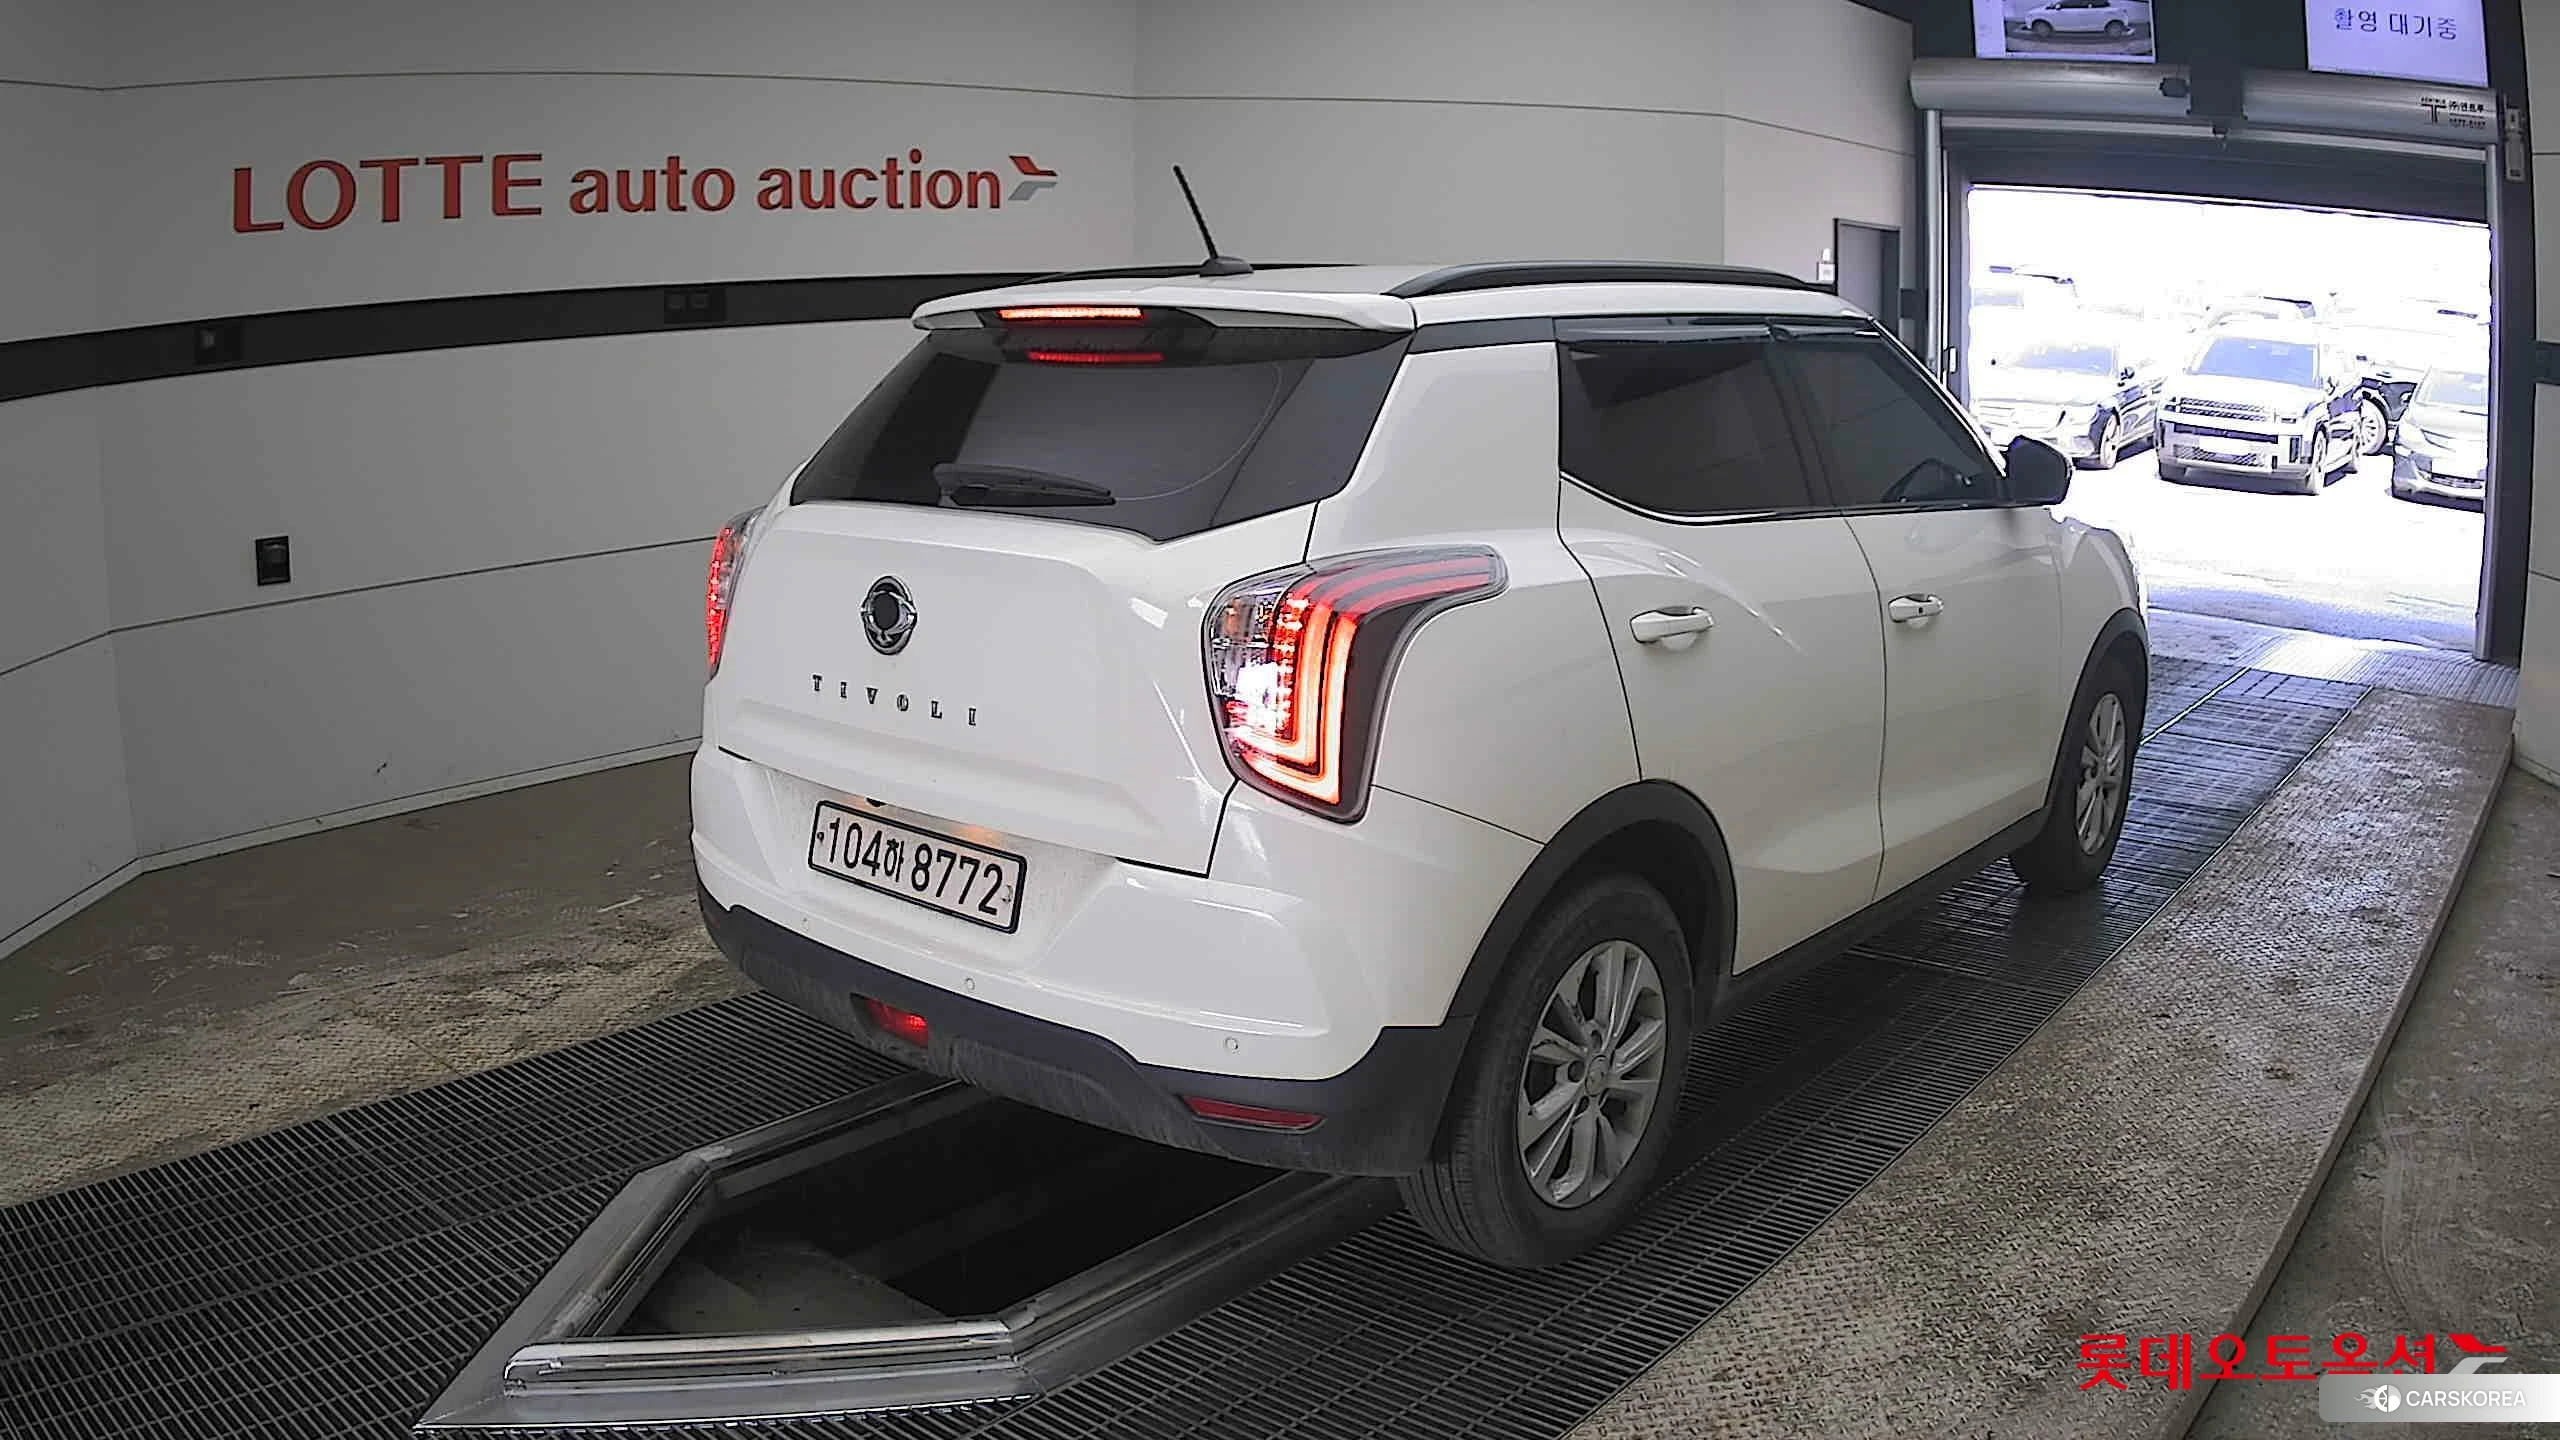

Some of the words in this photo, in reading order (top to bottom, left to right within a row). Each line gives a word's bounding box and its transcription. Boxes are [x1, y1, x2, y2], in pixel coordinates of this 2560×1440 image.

[2334, 7, 2378, 33] 촬영
[2388, 12, 2458, 41] 대기중
[234, 153, 542, 233] LOTTE
[570, 155, 736, 213] auto
[756, 148, 1002, 210] auction
[812, 673, 978, 727] TIVOLI
[910, 842, 1004, 916] 8772
